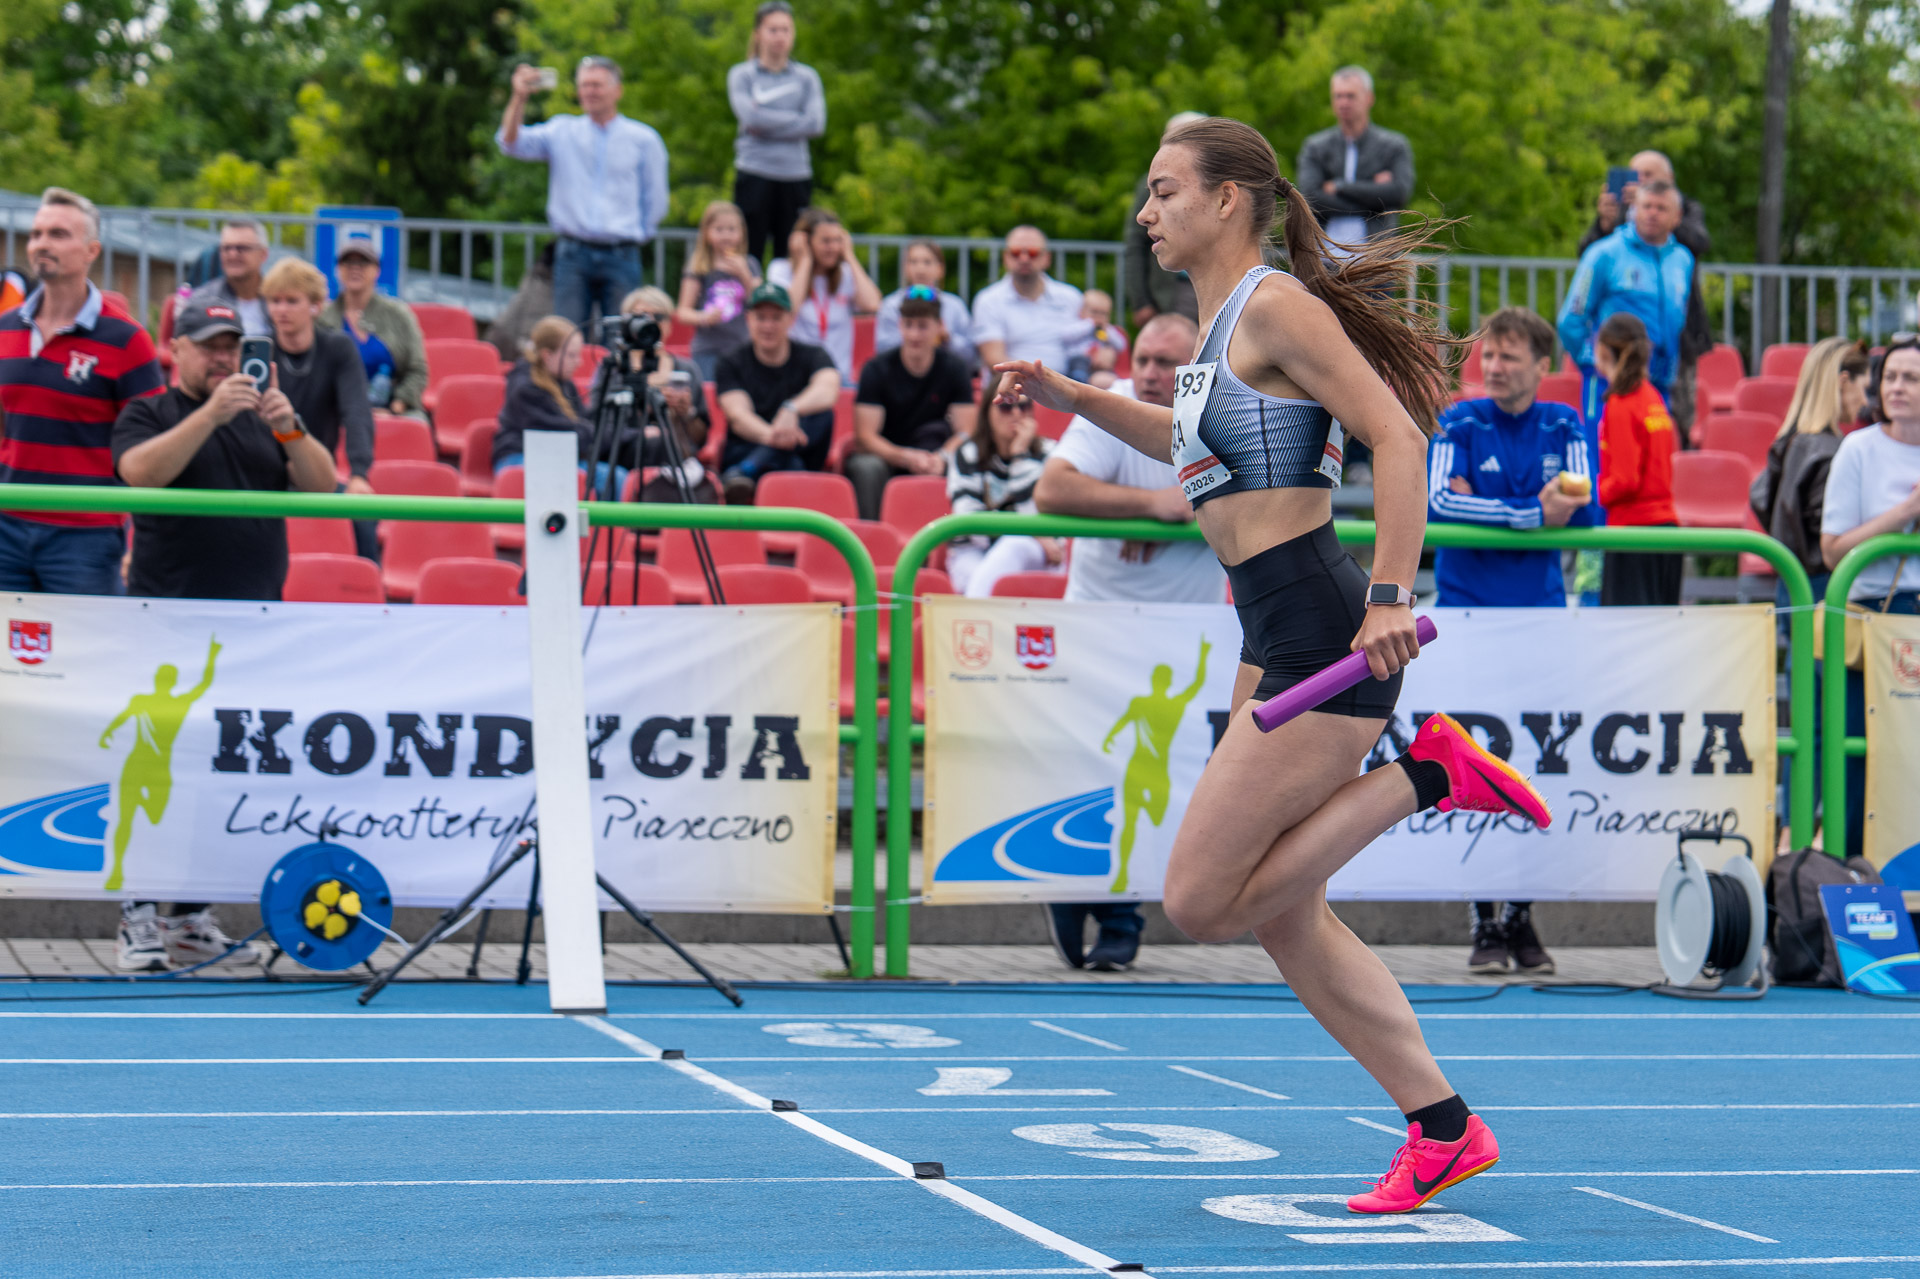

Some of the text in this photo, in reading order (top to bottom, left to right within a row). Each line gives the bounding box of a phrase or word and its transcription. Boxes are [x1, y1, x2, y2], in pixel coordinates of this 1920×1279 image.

[1190, 473, 1216, 492] 2026
[602, 795, 794, 843] Piaseczno
[761, 1022, 962, 1049] 8
[916, 1067, 1118, 1096] 7
[1011, 1122, 1280, 1162] 6
[1200, 1193, 1528, 1244] 5
